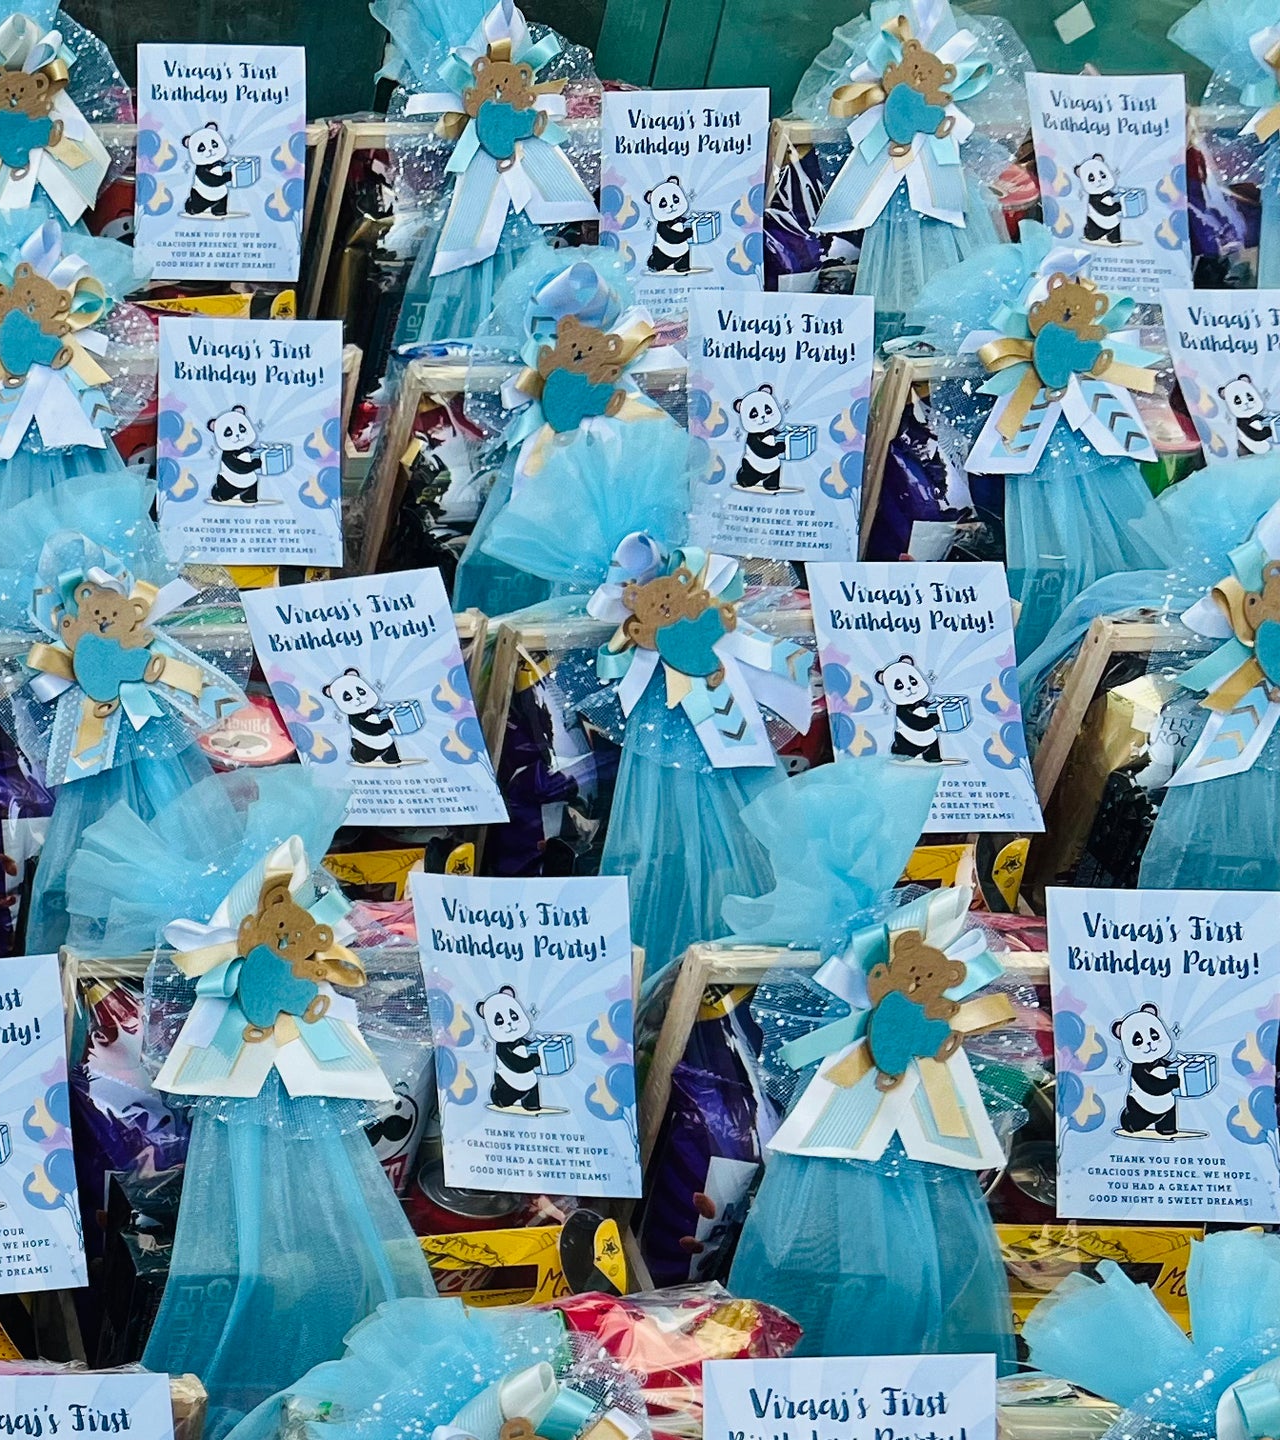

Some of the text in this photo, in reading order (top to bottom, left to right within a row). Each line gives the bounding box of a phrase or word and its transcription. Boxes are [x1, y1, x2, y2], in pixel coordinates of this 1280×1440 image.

[840, 581, 979, 605] Viraaj's First
[831, 609, 994, 633] Birthday Party!
[1082, 912, 1245, 943] Viraaj's First
[1068, 947, 1259, 979] Birthday Party!
[749, 1387, 950, 1422] Viraaj's First
